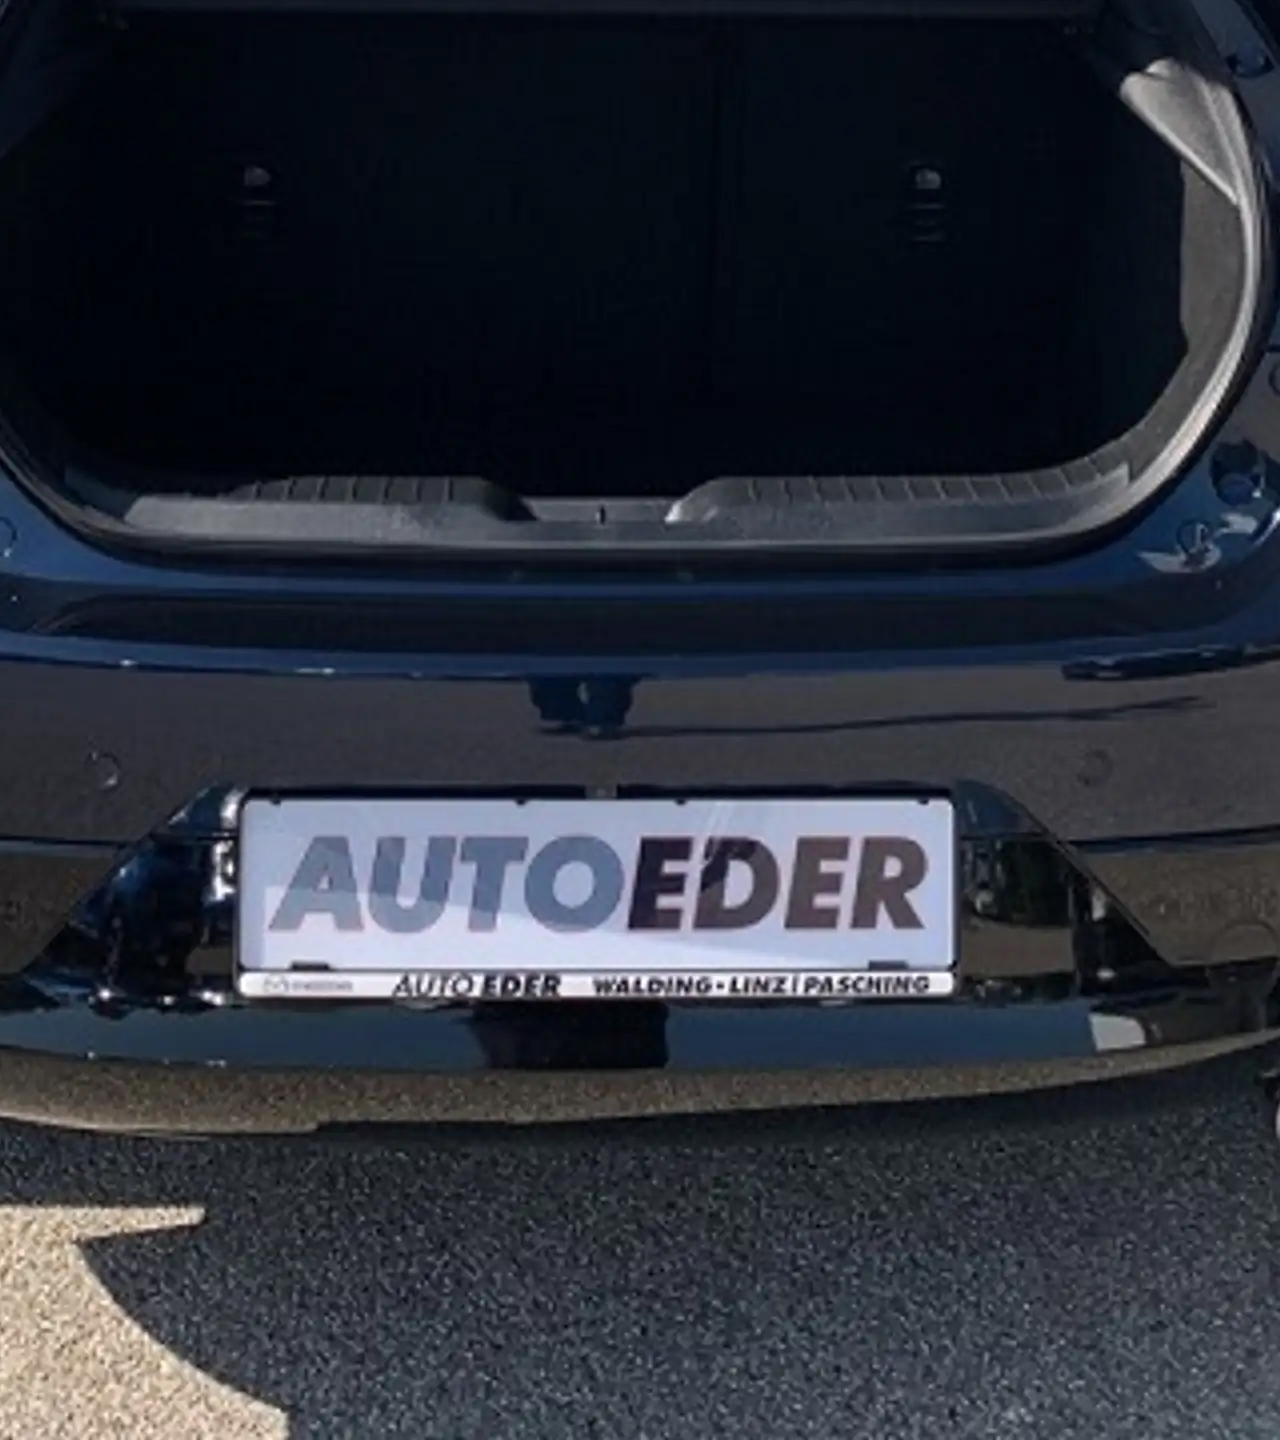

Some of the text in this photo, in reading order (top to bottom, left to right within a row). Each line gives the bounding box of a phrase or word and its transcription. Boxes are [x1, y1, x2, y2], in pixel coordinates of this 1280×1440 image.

[392, 972, 932, 997] AUTO EDER WALDING LINZ PASCHING
